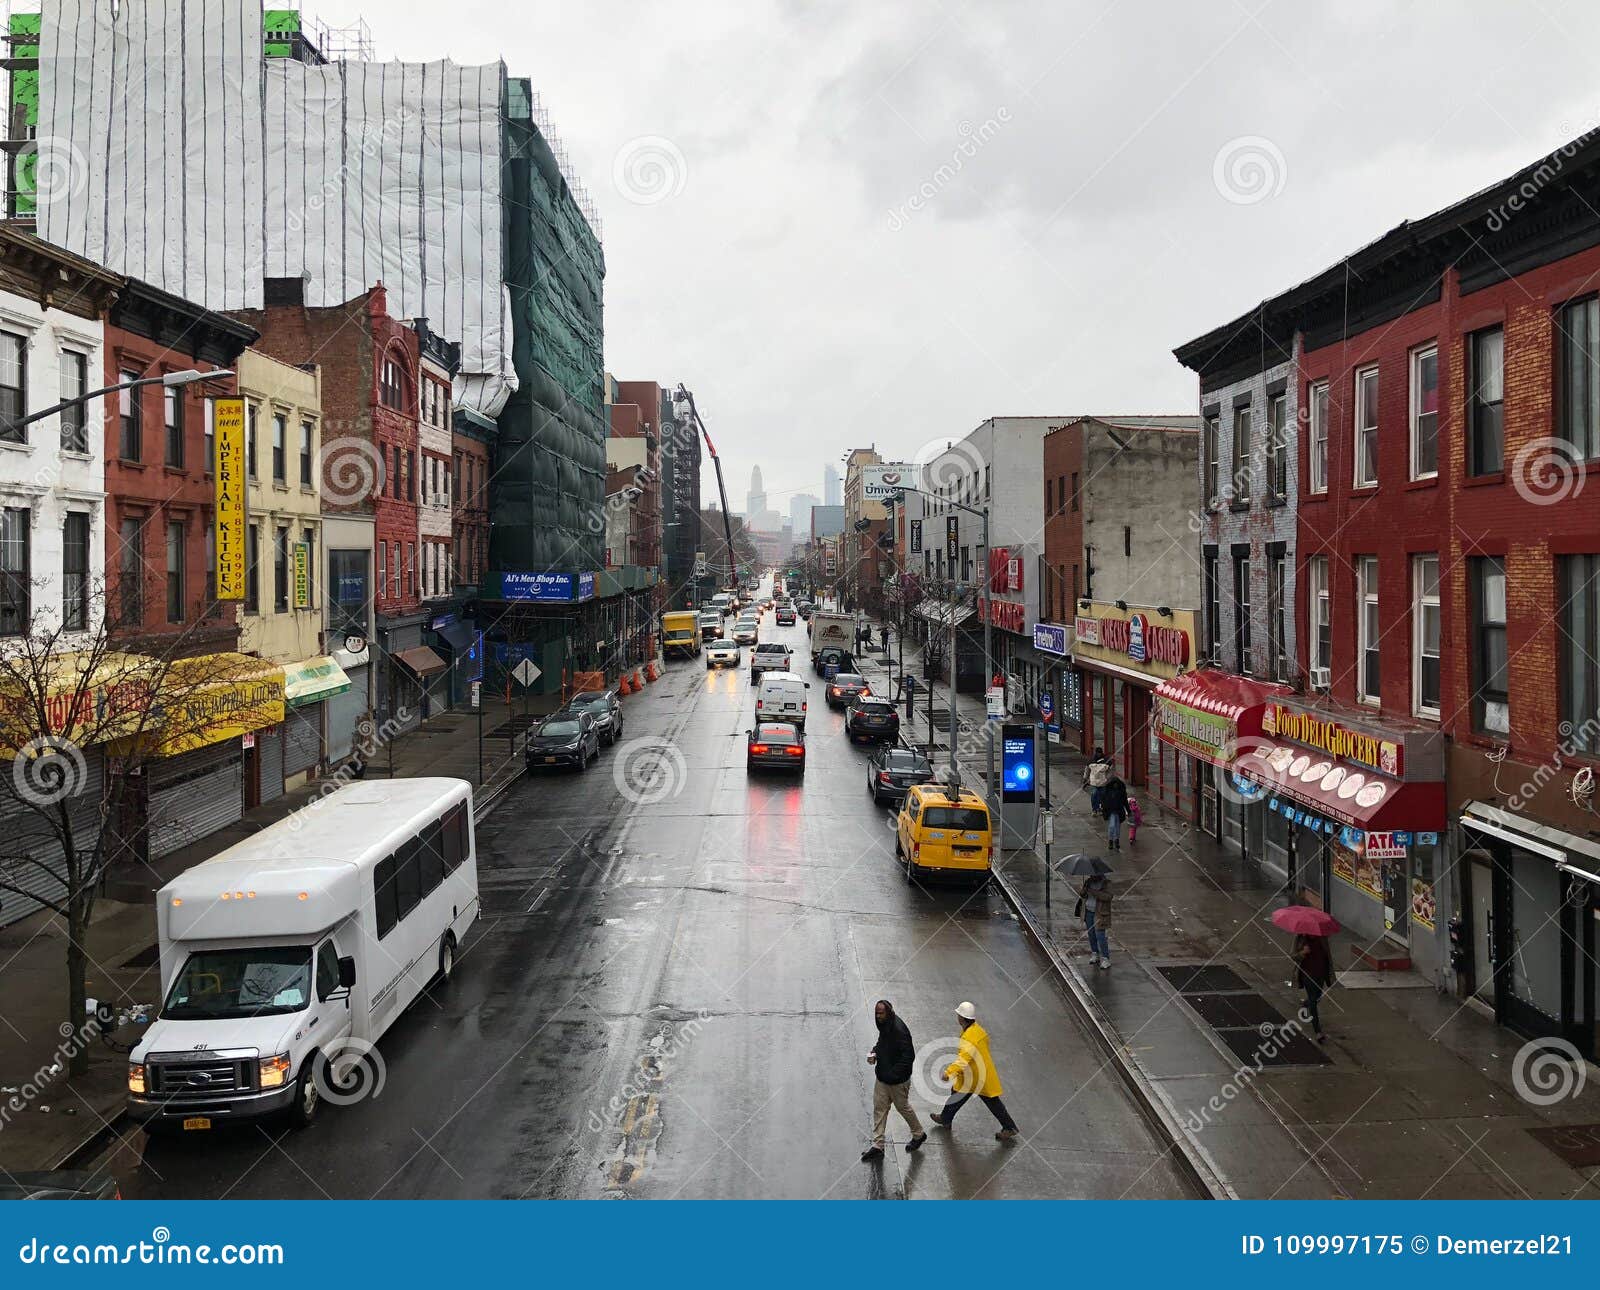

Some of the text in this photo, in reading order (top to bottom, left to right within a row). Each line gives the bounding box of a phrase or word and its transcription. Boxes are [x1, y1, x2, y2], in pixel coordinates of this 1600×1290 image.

[219, 432, 231, 593] IMPERIAL KITCHEN
[505, 574, 569, 584] Al's Men Shop Inc.
[1147, 625, 1184, 666] CASHED
[1275, 705, 1300, 740] FOOD
[1300, 713, 1326, 750] DELI
